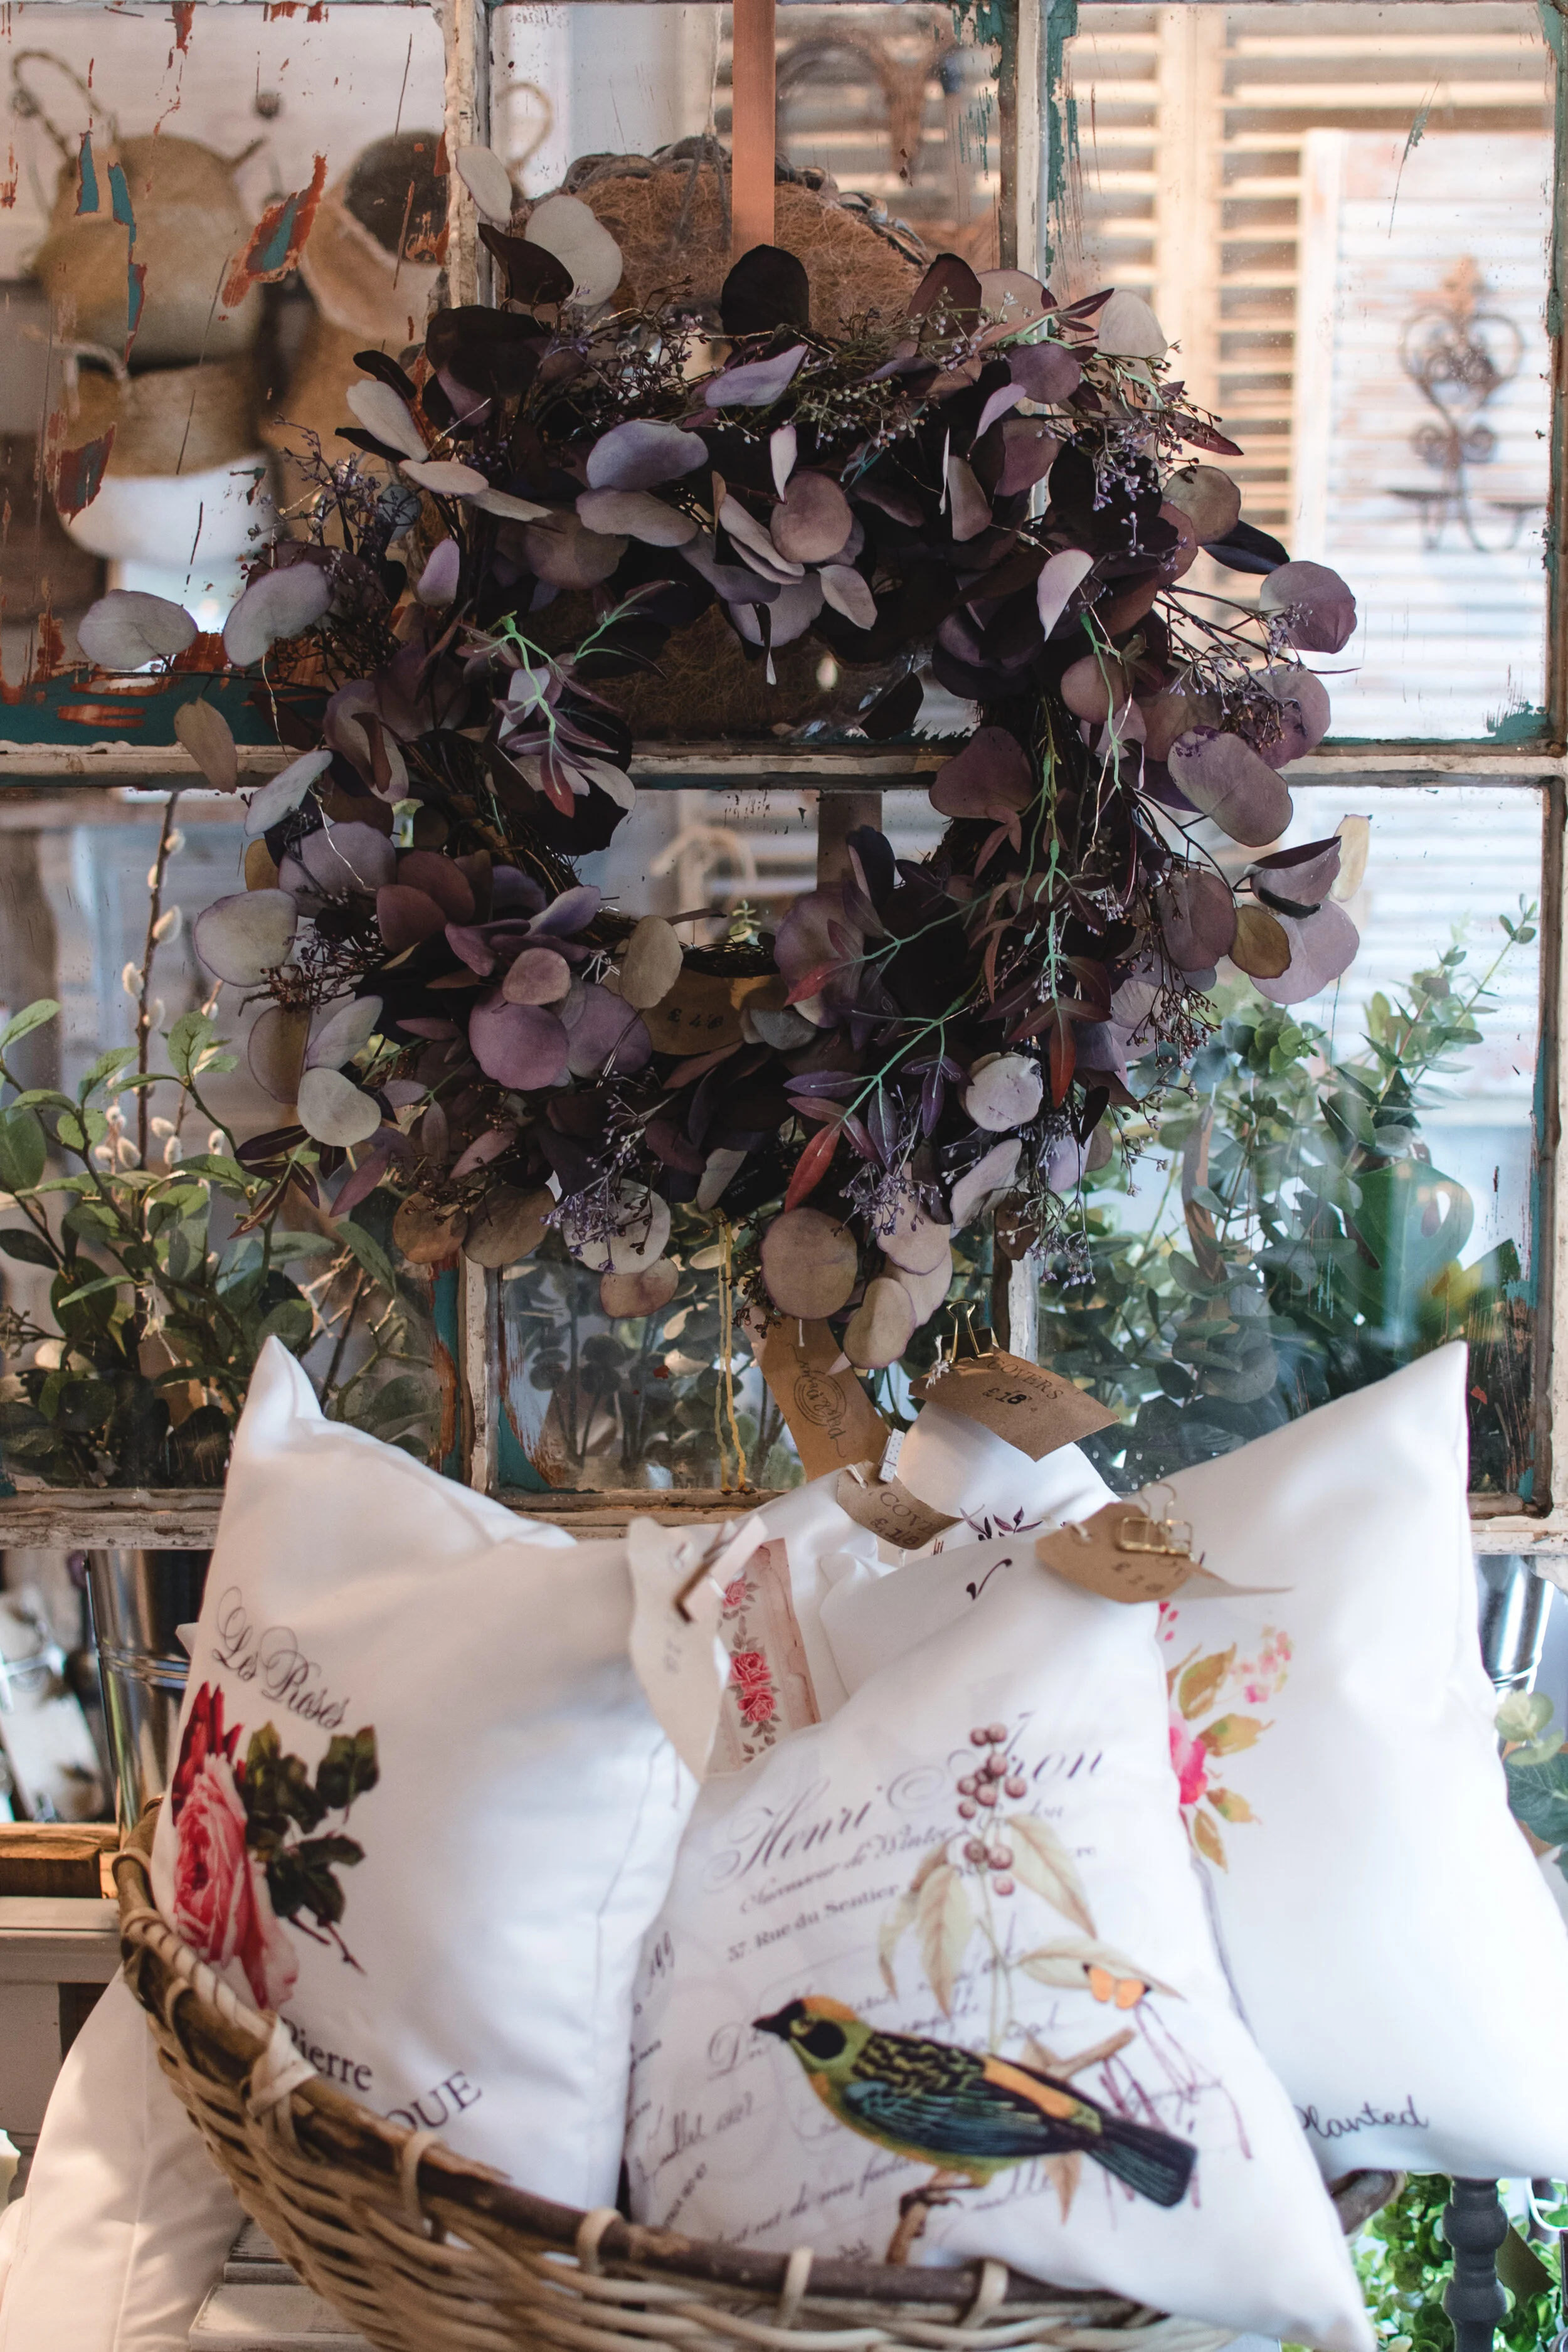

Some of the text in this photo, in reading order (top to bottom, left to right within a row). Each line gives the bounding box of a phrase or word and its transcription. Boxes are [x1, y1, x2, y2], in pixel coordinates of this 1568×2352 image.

[987, 1360, 1064, 1400] COVERS
[260, 1625, 350, 1729] Roses
[755, 1923, 791, 1947] Rue
[795, 1910, 820, 1931] du
[825, 1883, 900, 1914] Sentier
